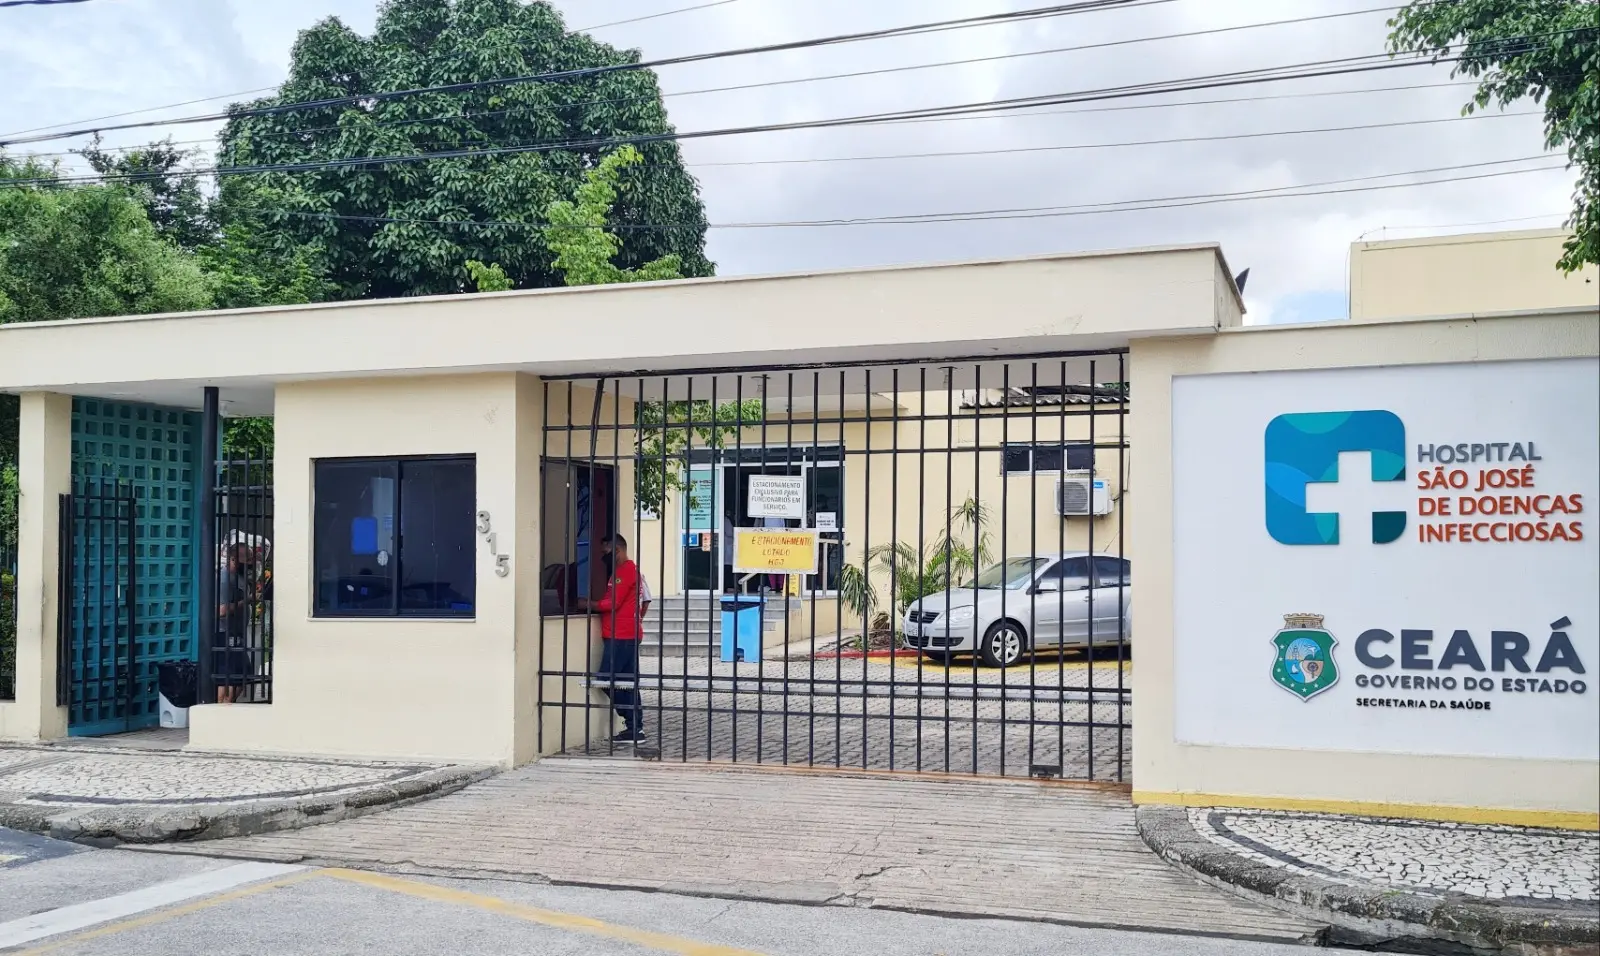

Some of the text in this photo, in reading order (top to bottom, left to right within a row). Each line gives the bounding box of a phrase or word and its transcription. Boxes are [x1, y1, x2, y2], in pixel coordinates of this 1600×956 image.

[1417, 442, 1542, 463] HOSPITAL
[752, 481, 801, 489] ESTACIONAMENTO
[1417, 463, 1535, 493] SÃO JOSÉ
[1418, 494, 1583, 519] DE DOENÇAS
[751, 535, 813, 546] ESTACIONAMENTO
[1418, 521, 1583, 543] INFECCIOSAS
[477, 510, 511, 578] 315
[762, 548, 791, 556] LOTADO
[1354, 615, 1587, 674] CEARÁ
[1354, 674, 1587, 694] GOVERNO DO ESTADO
[1355, 697, 1491, 711] SECRETARIA DA SAÚDE
